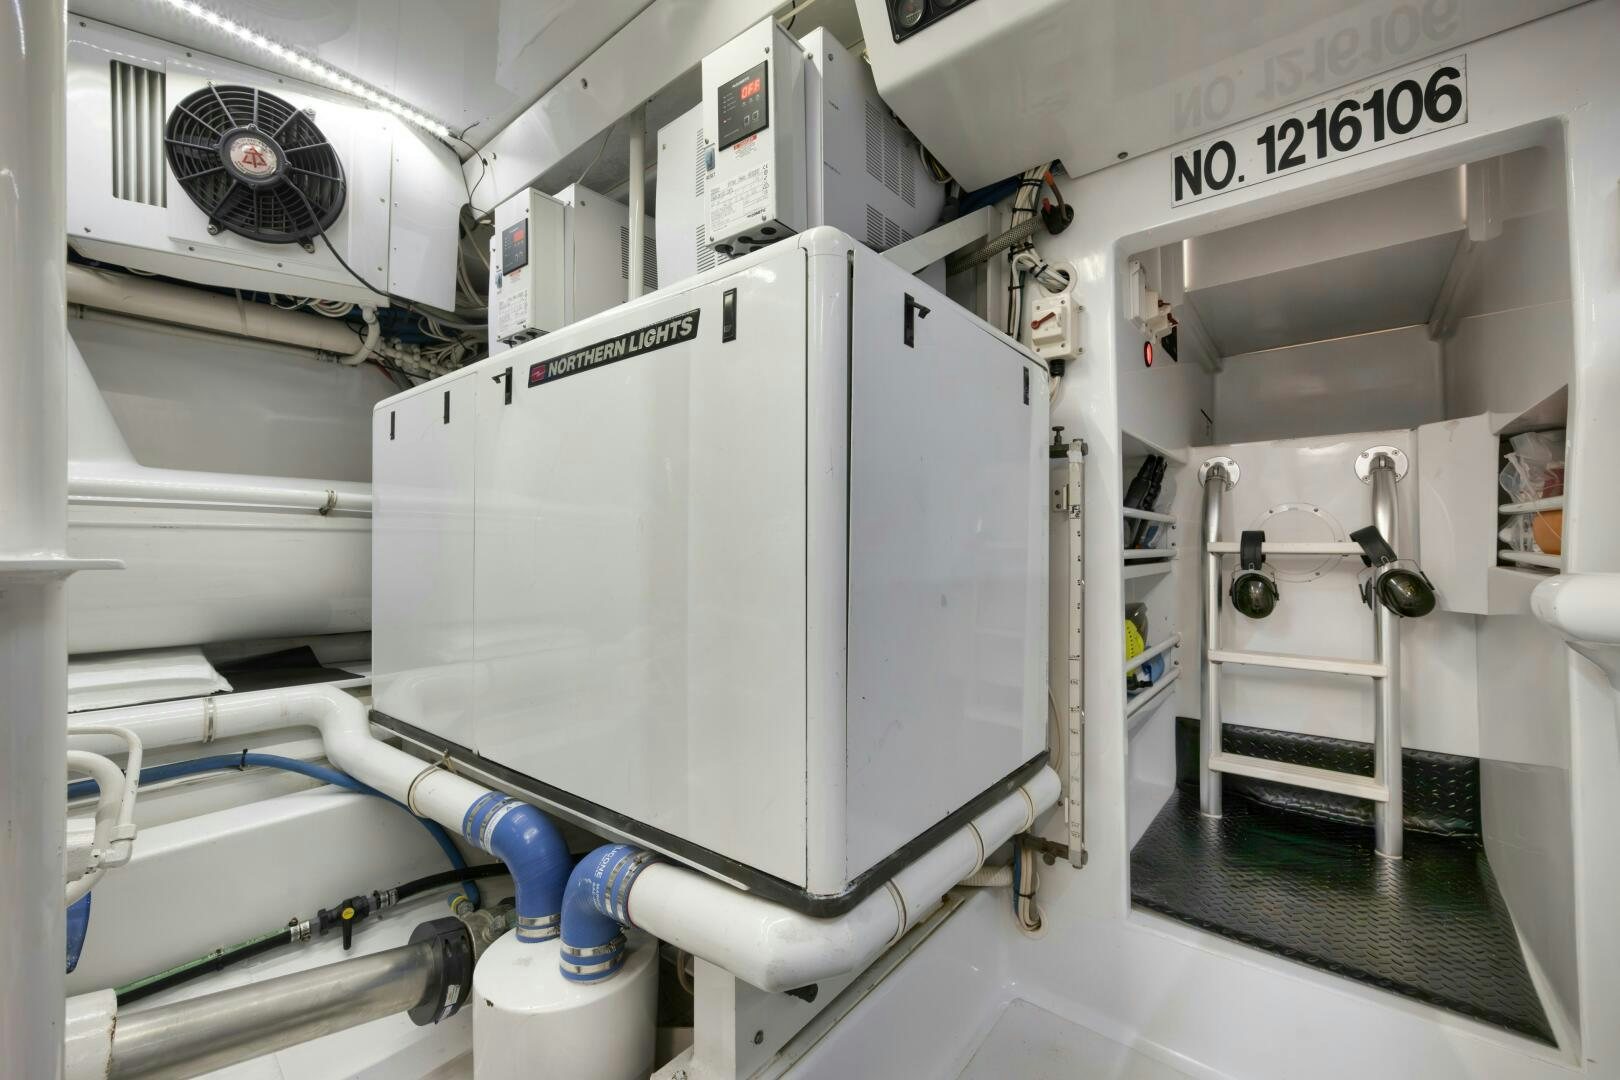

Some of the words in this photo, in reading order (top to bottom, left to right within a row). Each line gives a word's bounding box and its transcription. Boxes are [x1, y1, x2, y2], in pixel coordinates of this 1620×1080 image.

[1174, 140, 1245, 202] NO.
[1257, 66, 1463, 175] 1216106
[547, 338, 626, 377] NORTHERN
[629, 316, 694, 352] LIGHTS
